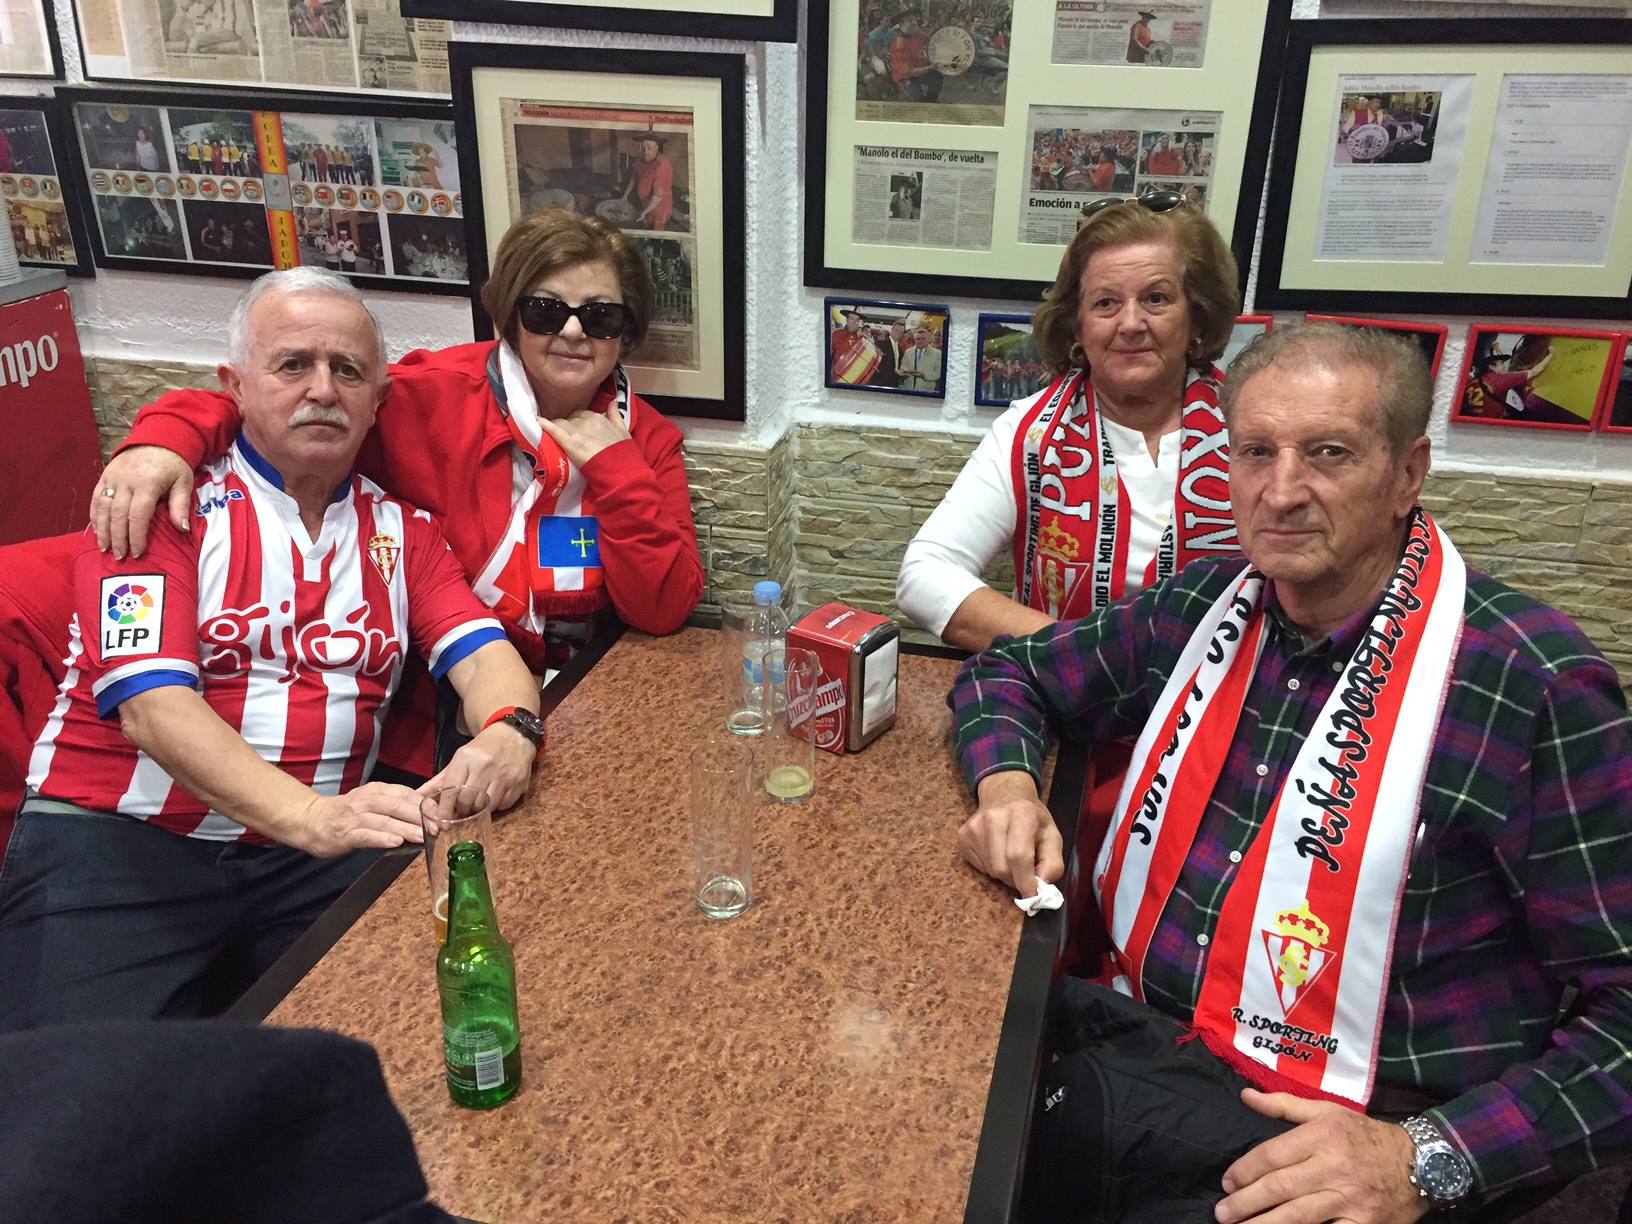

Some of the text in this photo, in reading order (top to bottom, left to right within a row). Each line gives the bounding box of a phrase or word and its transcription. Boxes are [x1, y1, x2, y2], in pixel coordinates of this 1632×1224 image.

[891, 149, 899, 158] el
[900, 149, 912, 159] del
[948, 152, 958, 162] de
[959, 153, 985, 163] vuelta
[1029, 197, 1080, 209] Emoción a
[1024, 452, 1041, 493] GIJÓN
[1030, 496, 1041, 513] DE
[1025, 515, 1041, 578] SPORTING
[1097, 503, 1117, 565] MOLINÓN
[1096, 567, 1110, 583] EL
[106, 627, 149, 650] LFP
[1294, 756, 1360, 873] PEÑA
[1232, 1007, 1339, 1054] R. SPORTING
[1252, 1035, 1313, 1062] GIJÓN
